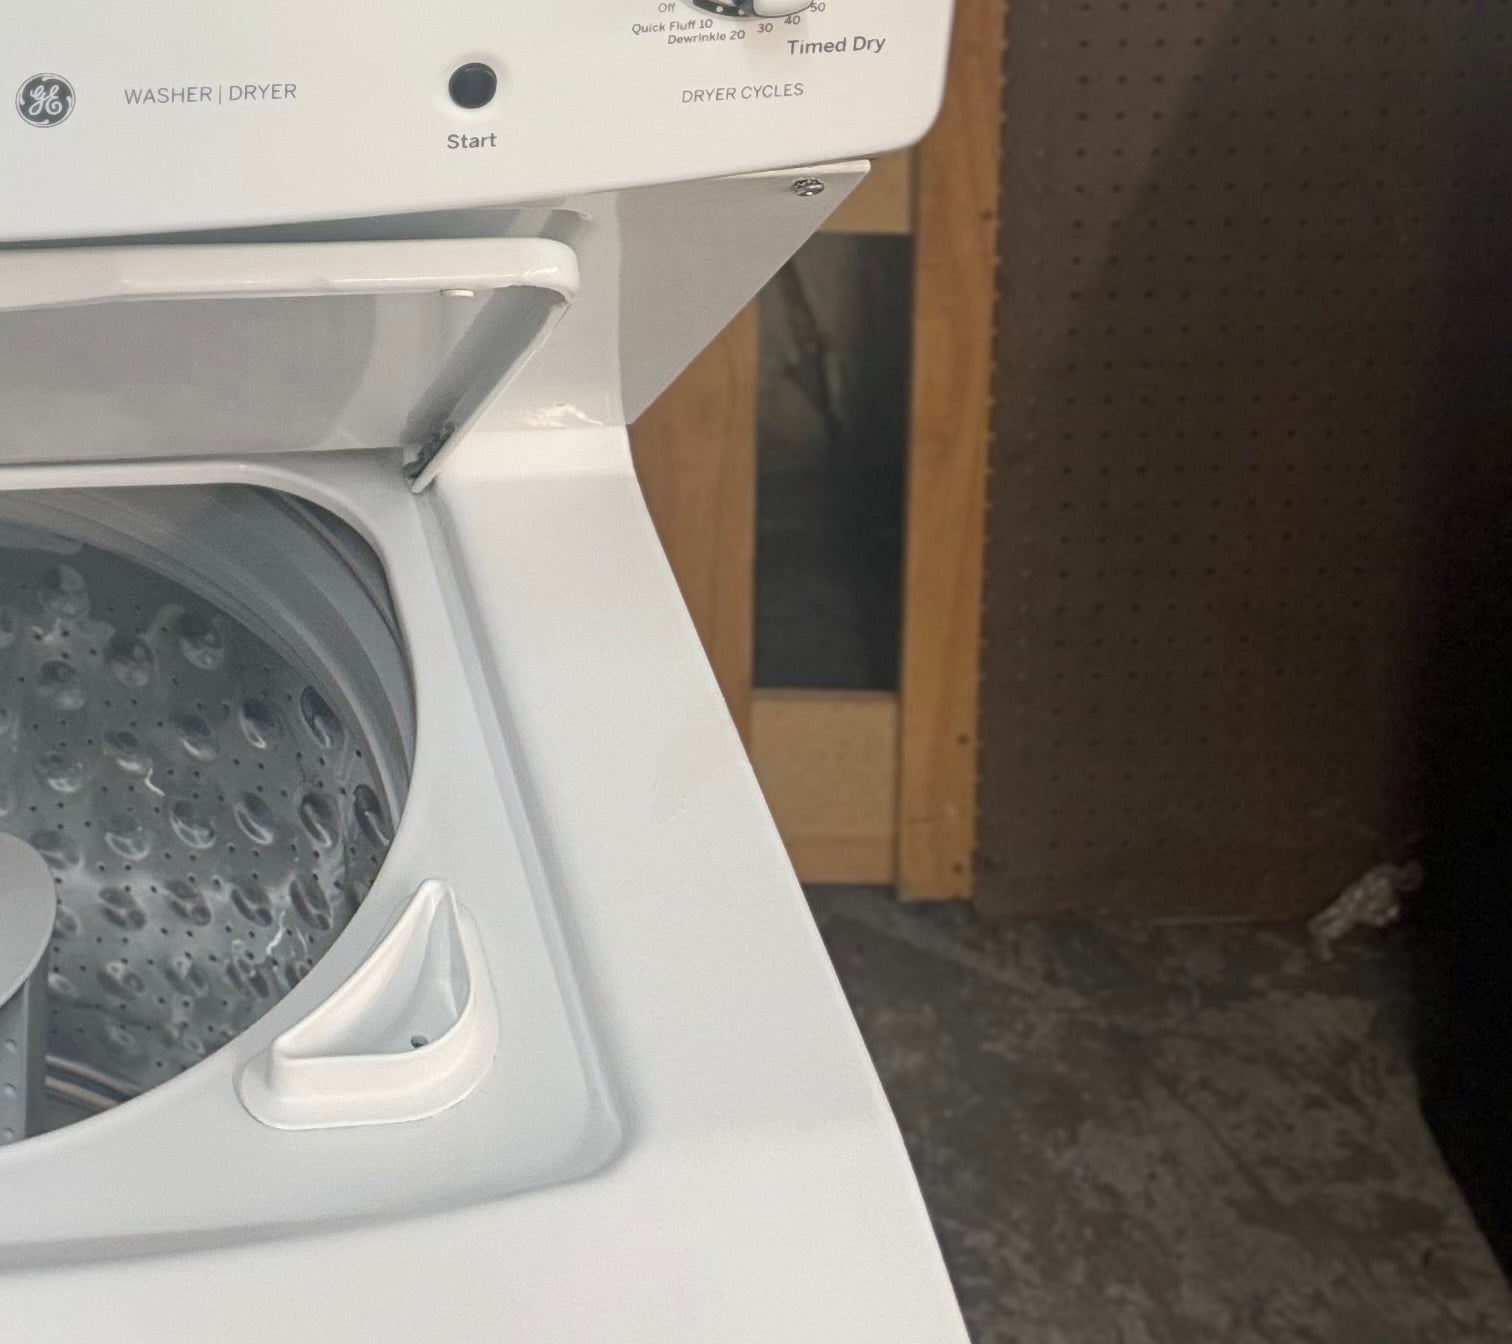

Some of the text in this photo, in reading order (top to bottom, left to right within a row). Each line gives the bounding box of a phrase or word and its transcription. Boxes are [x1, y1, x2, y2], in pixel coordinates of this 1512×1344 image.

[658, 3, 676, 14] Off
[810, 2, 827, 14] 50
[631, 19, 713, 36] Quick Fluff 10
[757, 23, 774, 34] 30
[784, 15, 801, 27] 40
[668, 30, 746, 45] Dewrinkle 20
[787, 36, 886, 55] Timed Dry
[124, 83, 298, 105] WASHER DRYER
[682, 82, 805, 104] DRYER CYCLES
[446, 132, 498, 150] Start
